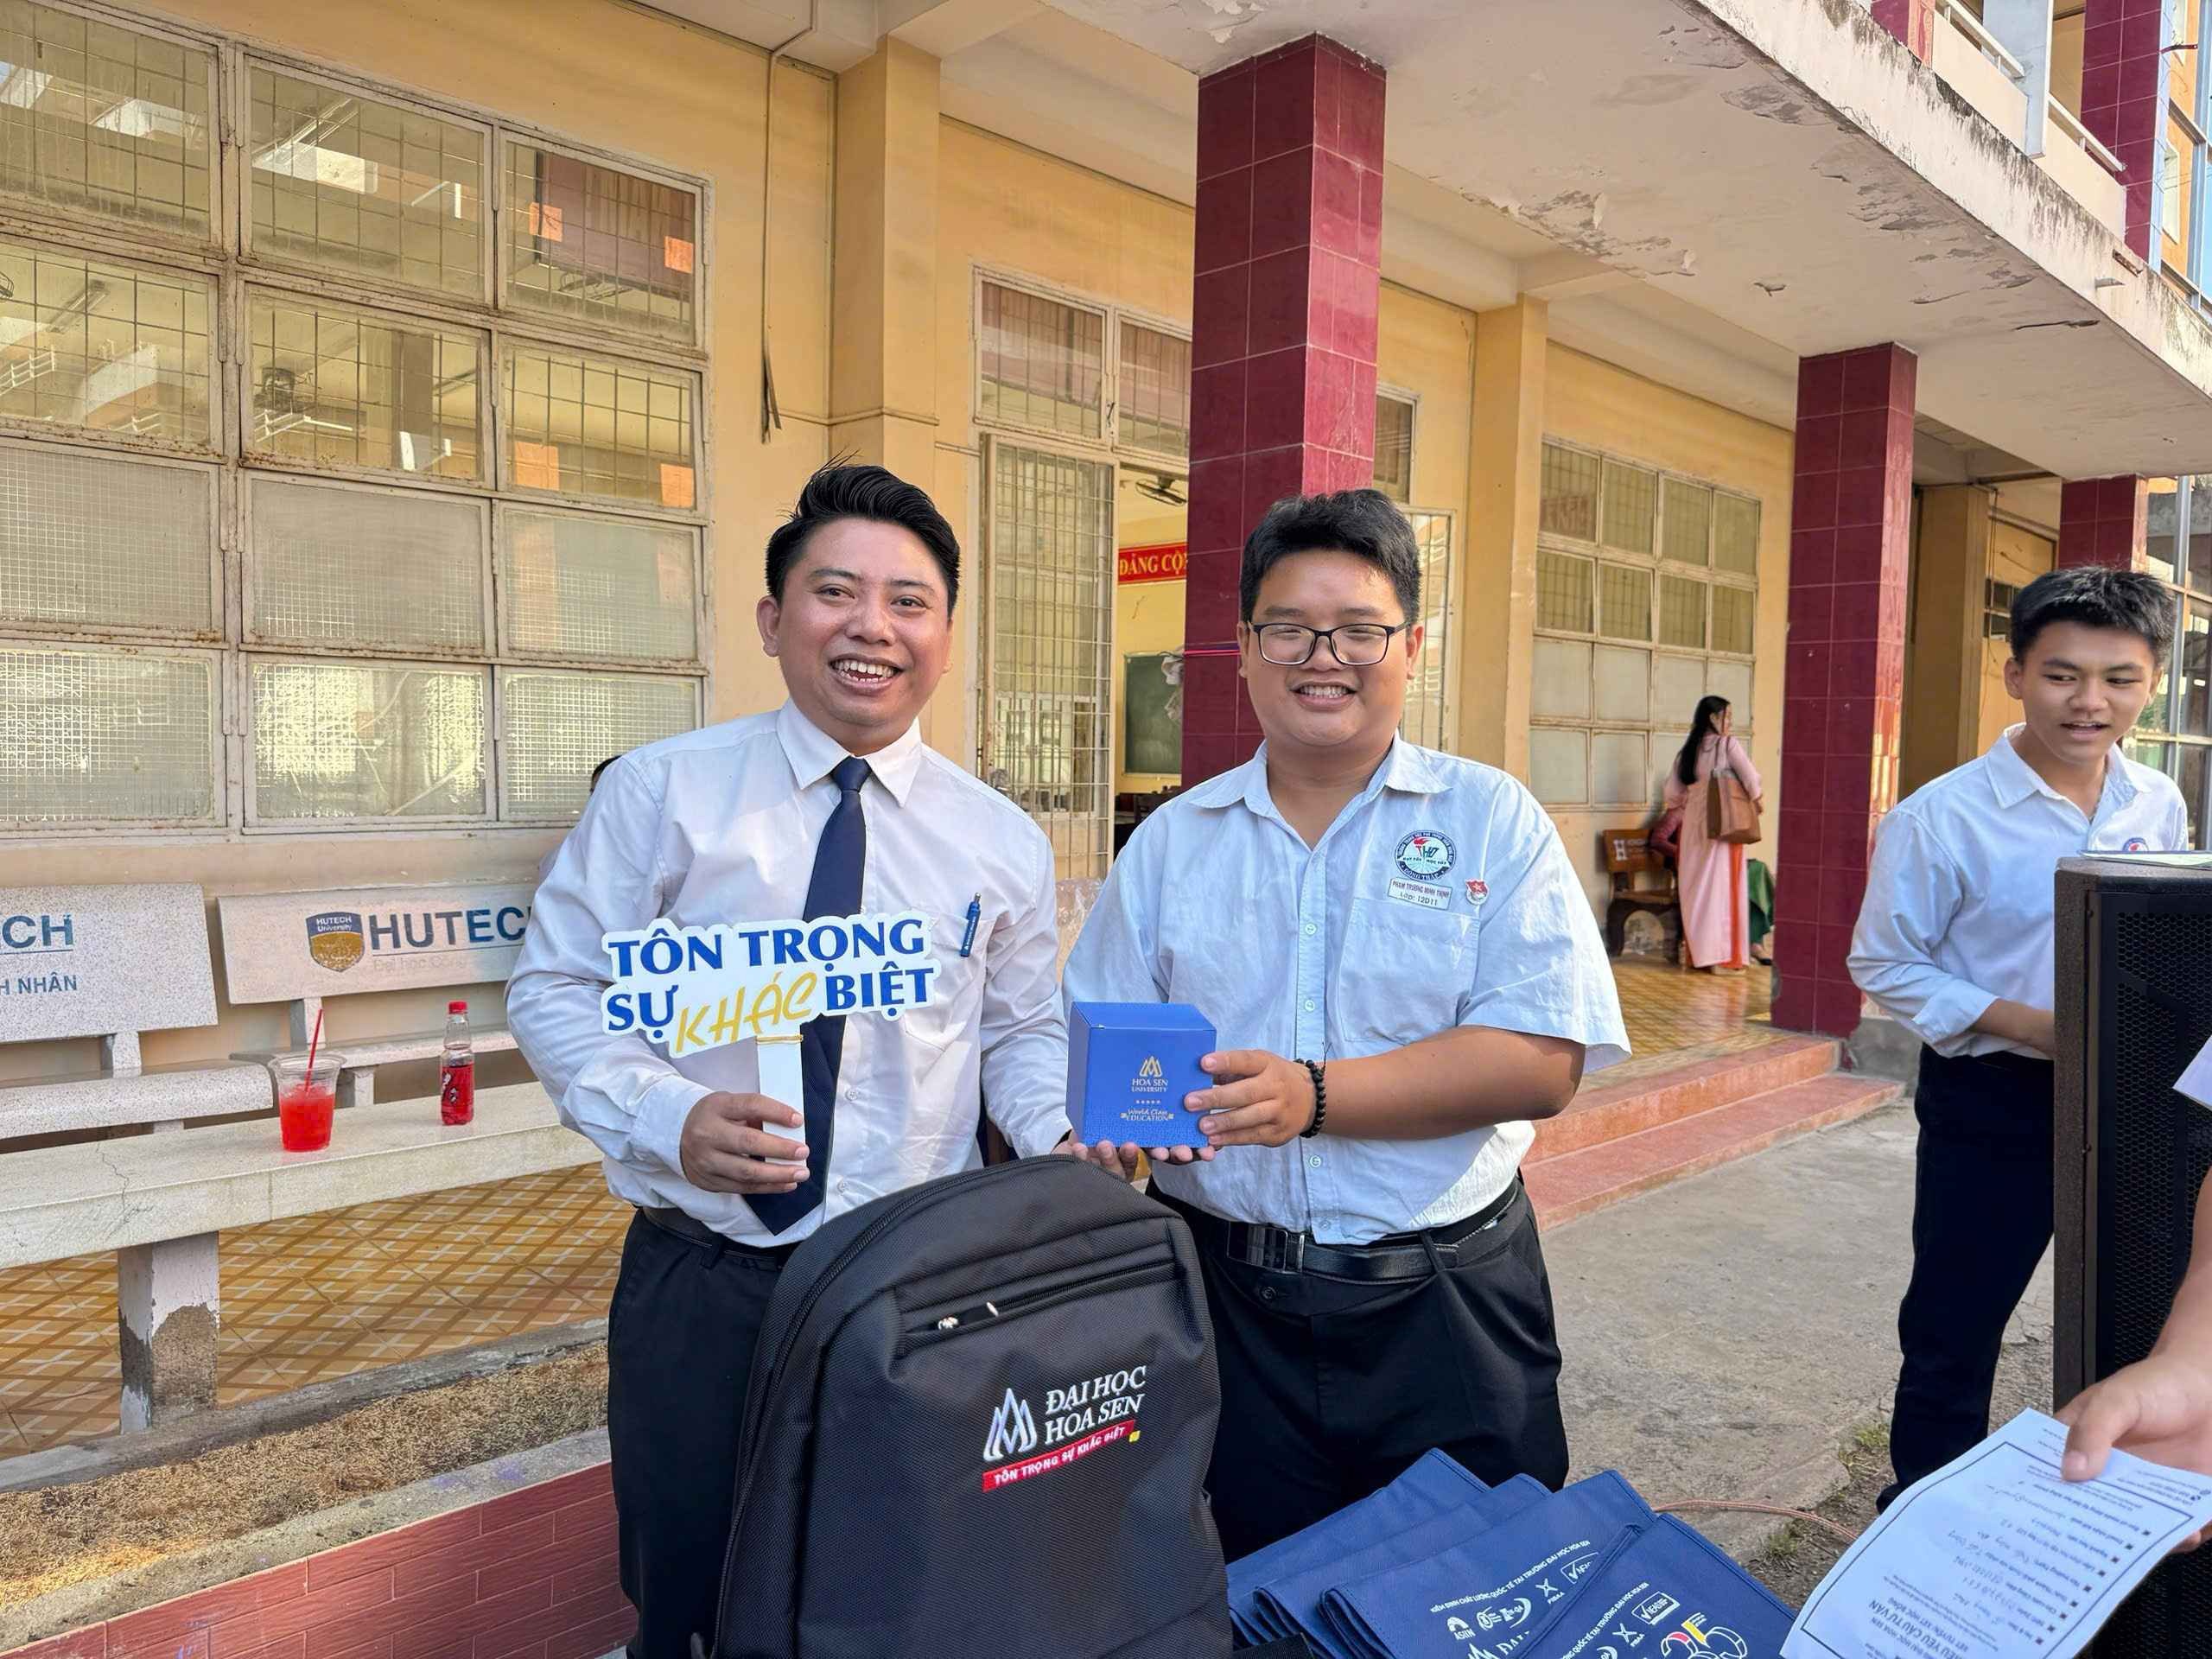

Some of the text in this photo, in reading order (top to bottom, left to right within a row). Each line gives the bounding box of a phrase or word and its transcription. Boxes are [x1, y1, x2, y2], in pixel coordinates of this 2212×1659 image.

[1119, 553, 1158, 575] ĐẢNG
[316, 916, 352, 925] HUTECH
[368, 906, 531, 950] HUTEC
[607, 918, 925, 977] TÔN TRỌNG
[18, 971, 77, 994] NHÂN
[607, 961, 935, 1054] SỰ KHÁC BIỆT
[1046, 1365, 1147, 1414] ĐẠI HỌC
[1045, 1394, 1145, 1445] HOA SEN
[995, 1470, 1018, 1484] TÔN
[1021, 1456, 1058, 1475] TRỌNG
[1061, 1447, 1075, 1461] SỰ
[1077, 1436, 1102, 1455] KHÁC
